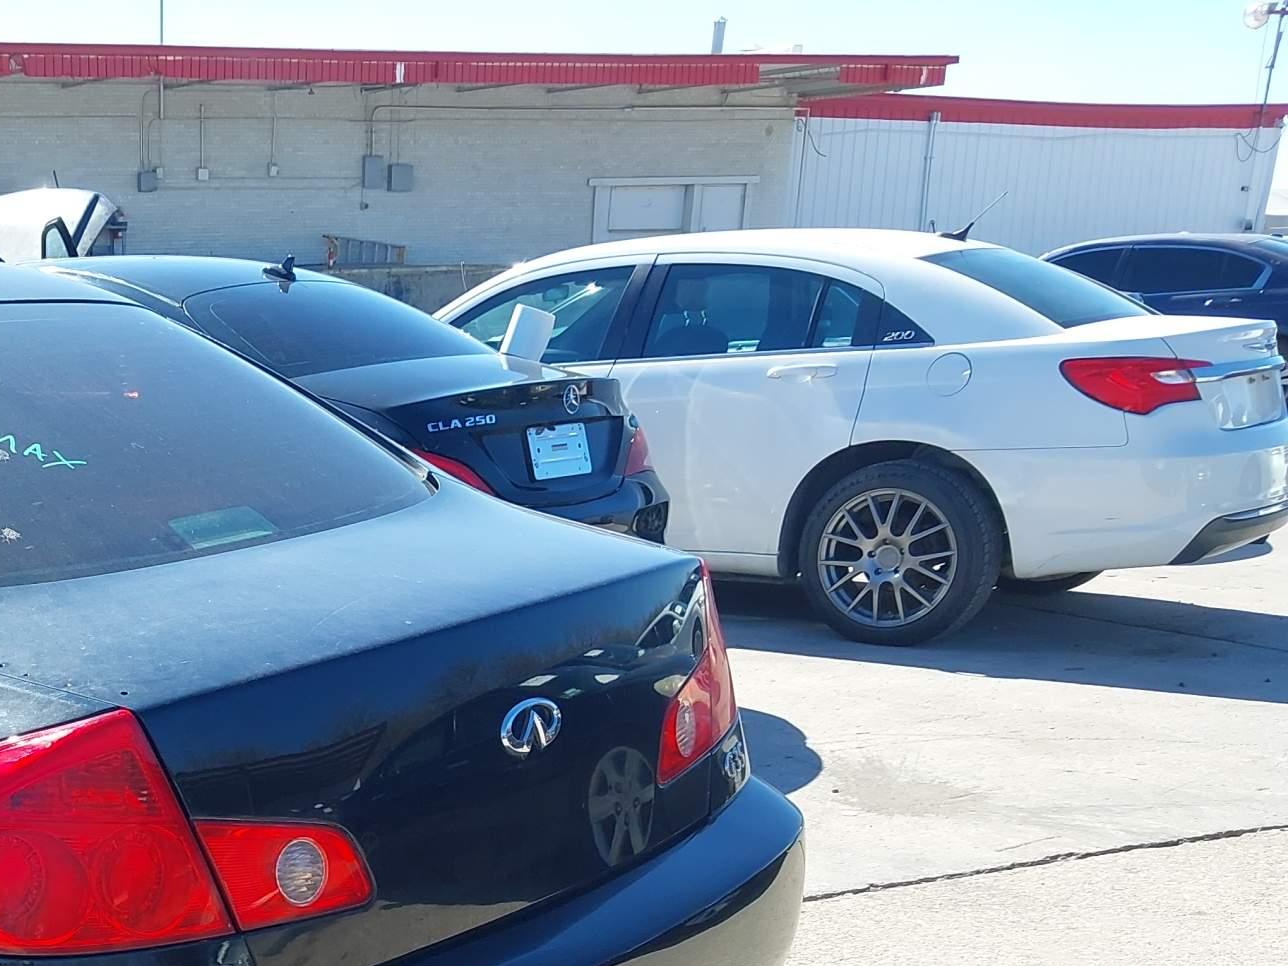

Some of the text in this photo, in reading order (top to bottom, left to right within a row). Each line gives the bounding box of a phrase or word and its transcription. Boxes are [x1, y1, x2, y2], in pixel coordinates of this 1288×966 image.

[882, 330, 915, 342] 200
[427, 414, 496, 432] CLA 250
